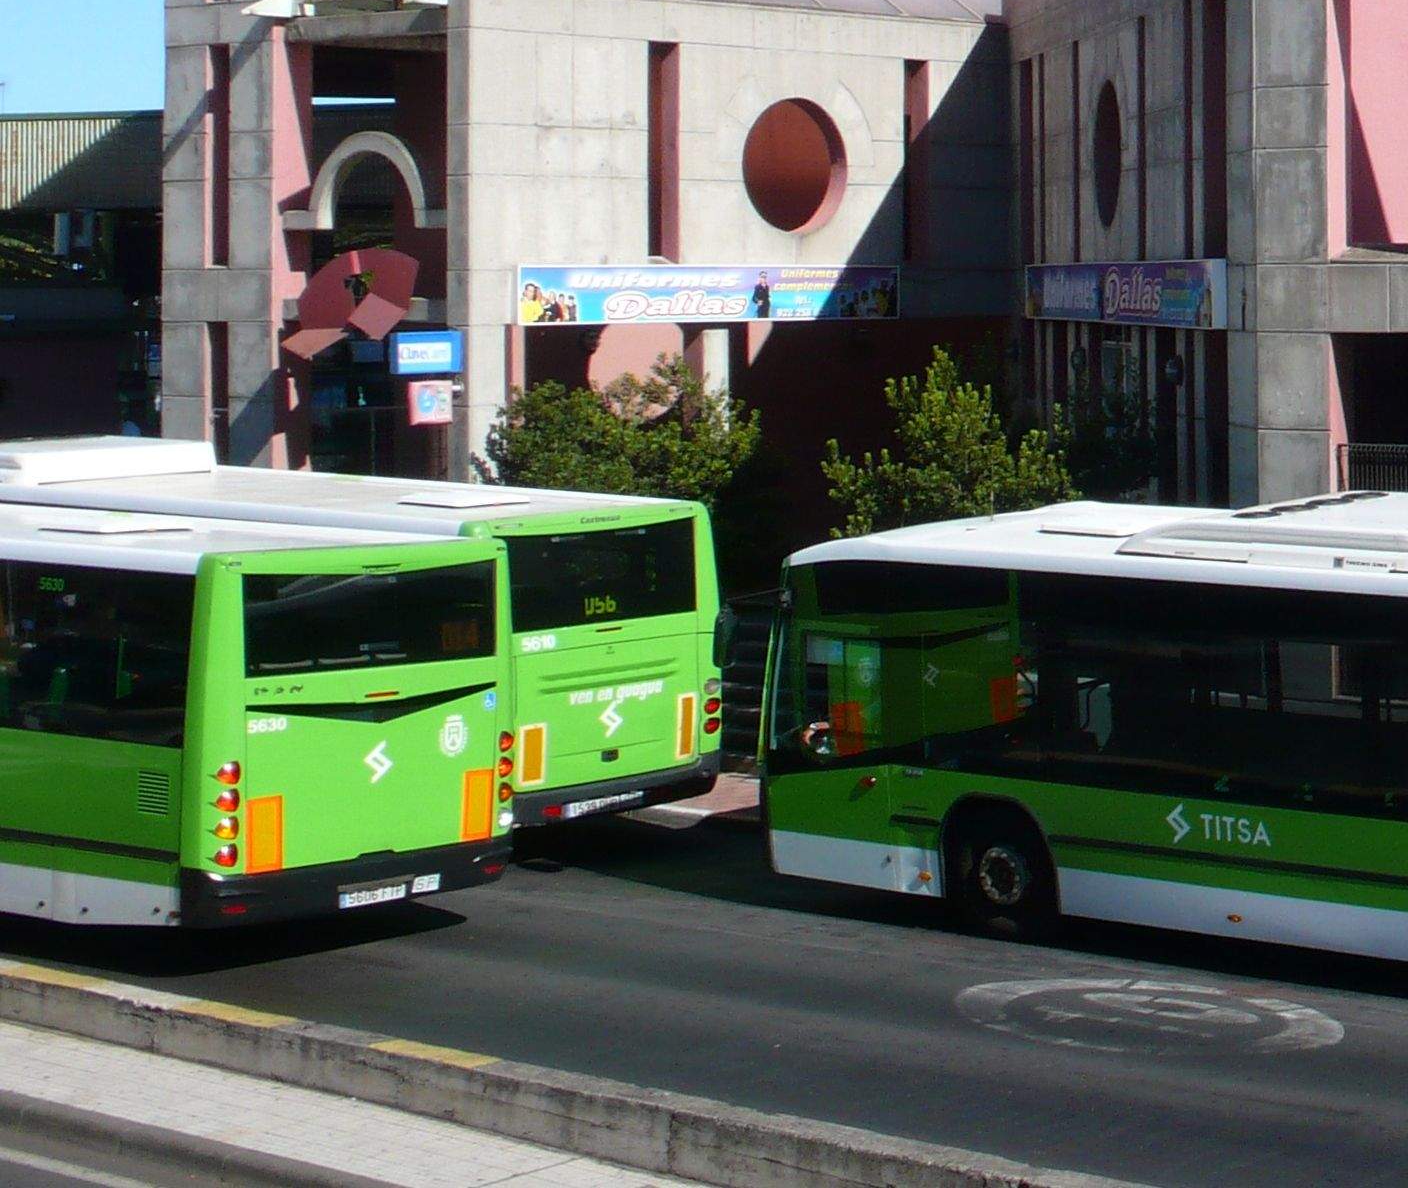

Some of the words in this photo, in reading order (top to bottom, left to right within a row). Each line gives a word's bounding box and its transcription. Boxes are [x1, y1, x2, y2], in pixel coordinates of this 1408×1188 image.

[568, 271, 740, 290] Uniformes
[605, 291, 747, 320] Dallas
[1104, 267, 1163, 320] Dallas
[521, 634, 556, 652] 5610
[570, 689, 593, 705] ven
[597, 687, 613, 702] en
[616, 680, 664, 704] guagua
[247, 717, 287, 734] 5630
[1200, 814, 1271, 847] TITSA
